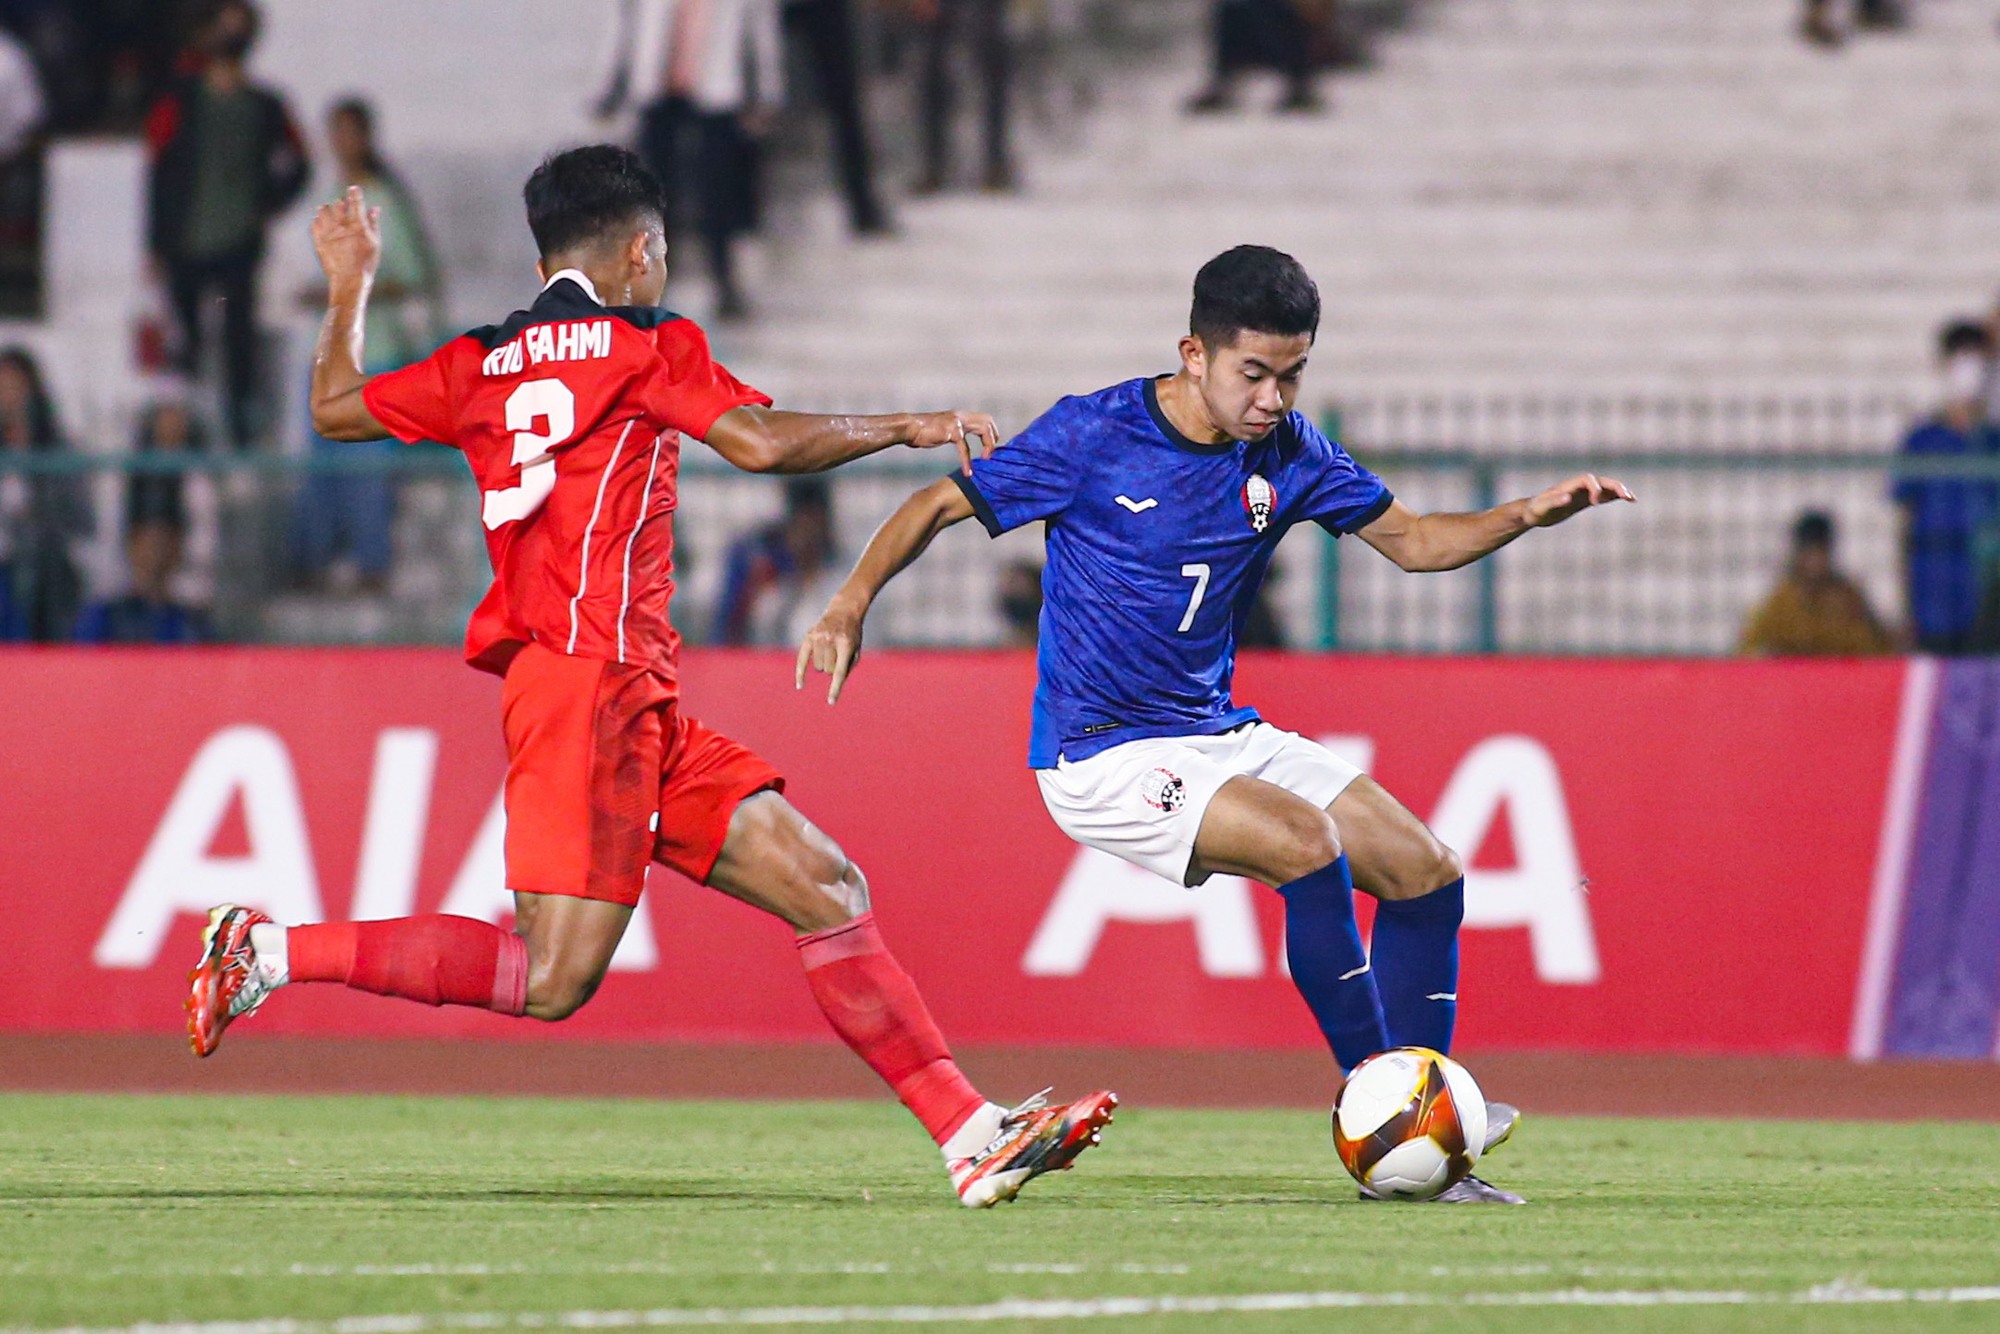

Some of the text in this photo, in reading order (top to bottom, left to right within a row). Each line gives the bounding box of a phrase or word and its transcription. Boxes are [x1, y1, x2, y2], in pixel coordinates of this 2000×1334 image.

[482, 320, 612, 376] RIO FAHMI
[482, 377, 575, 531] 3
[1177, 563, 1212, 632] 7
[92, 723, 660, 972] AI
[1022, 734, 1602, 984] AA
